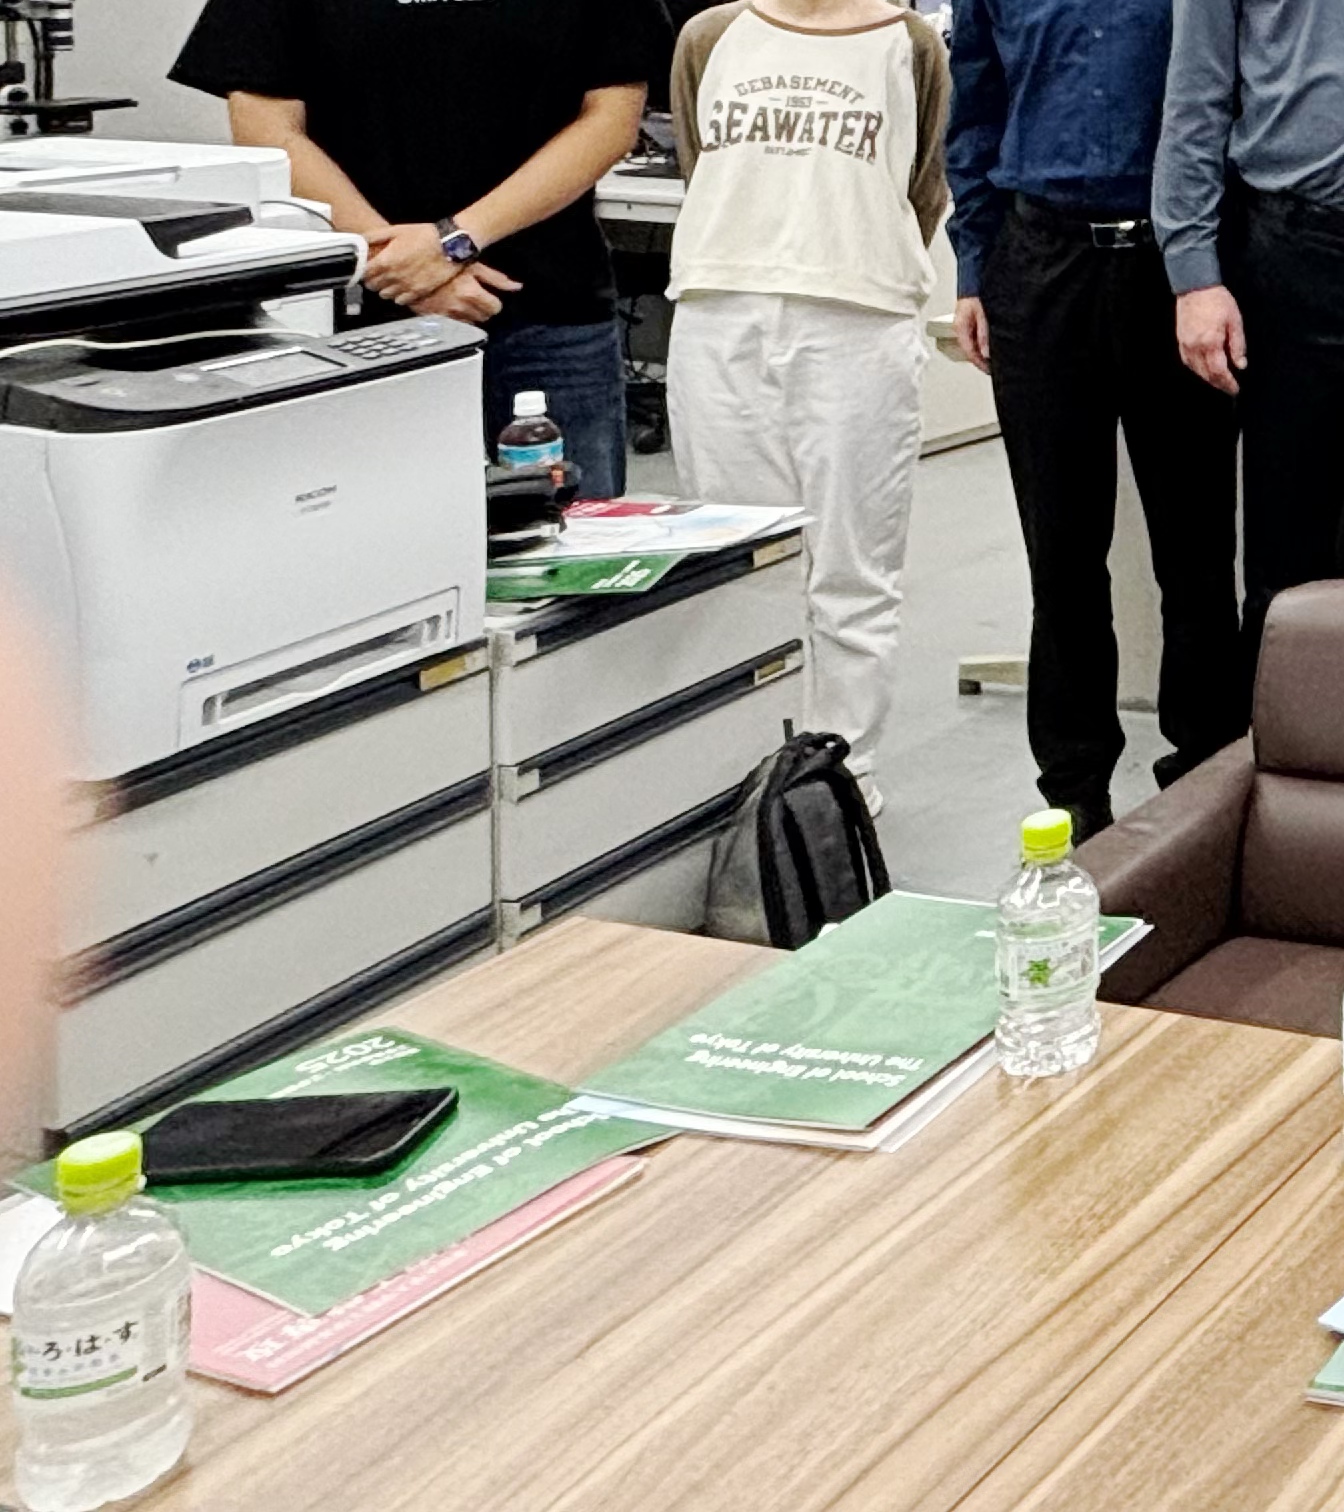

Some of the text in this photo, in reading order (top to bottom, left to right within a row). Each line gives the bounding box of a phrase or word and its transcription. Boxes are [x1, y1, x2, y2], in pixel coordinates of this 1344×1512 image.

[699, 99, 884, 166] SEAWATER
[294, 1036, 397, 1073] 2025
[689, 1033, 753, 1054] Tokyo
[405, 1121, 540, 1191] University
[492, 1146, 522, 1167] of
[322, 1164, 494, 1251] Engineering
[270, 1211, 371, 1257] Tokyo
